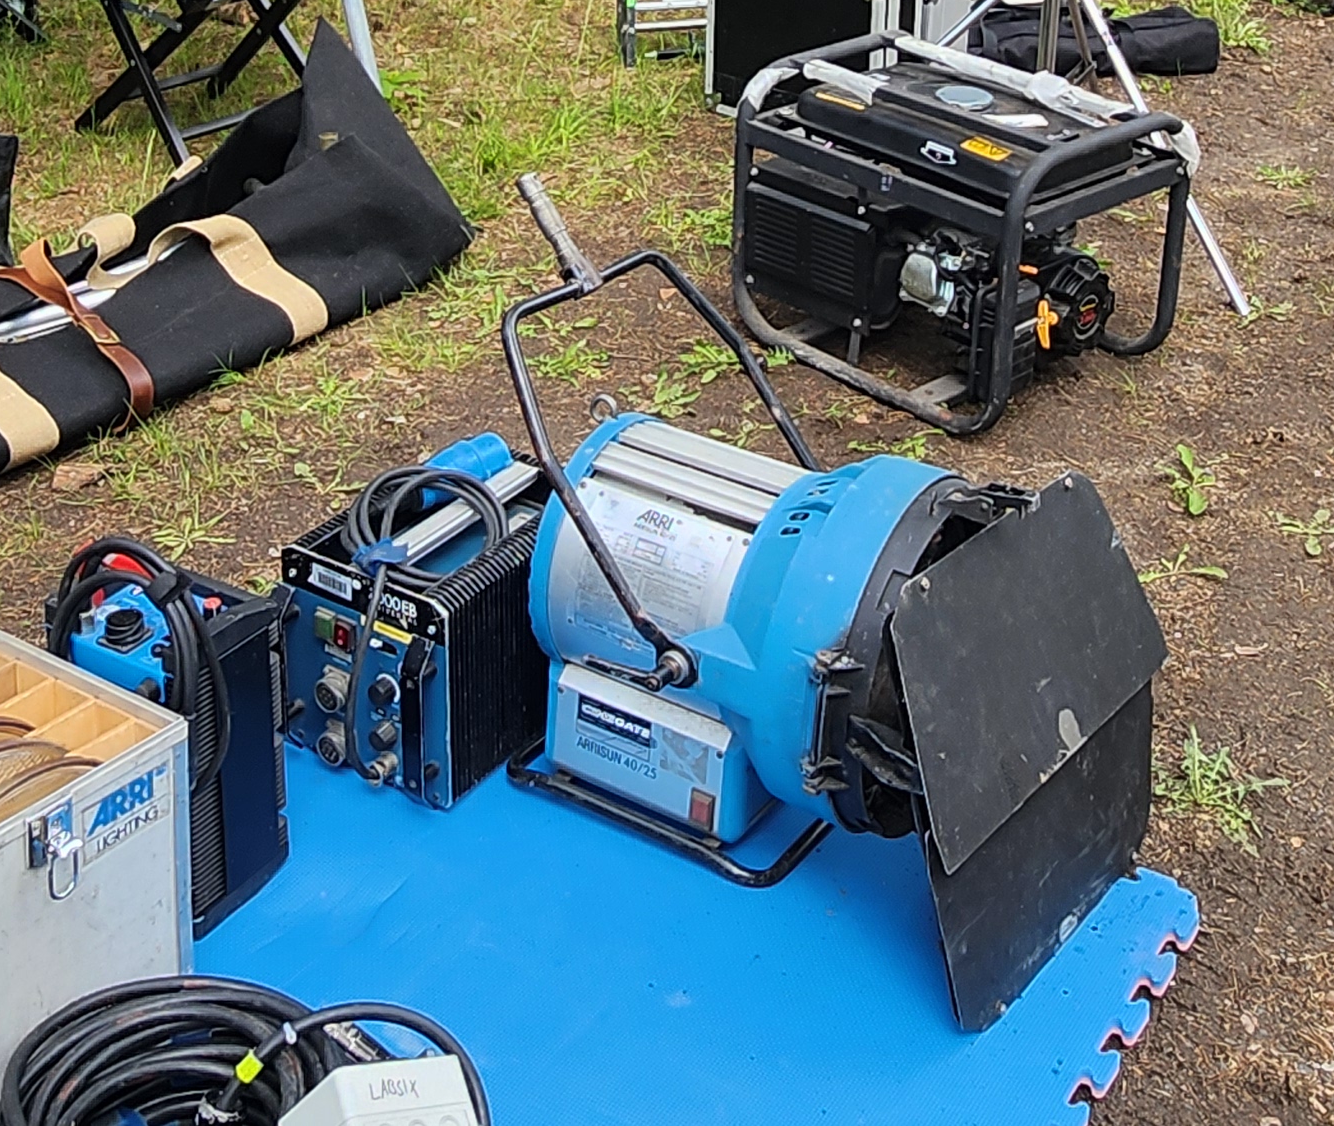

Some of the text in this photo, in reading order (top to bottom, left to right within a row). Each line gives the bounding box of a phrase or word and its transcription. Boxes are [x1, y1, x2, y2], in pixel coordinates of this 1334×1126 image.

[637, 509, 675, 531] ARRI
[576, 736, 658, 780] ARRISUN 40/25
[86, 769, 154, 838] ARRI
[96, 804, 159, 853] LIGHTING
